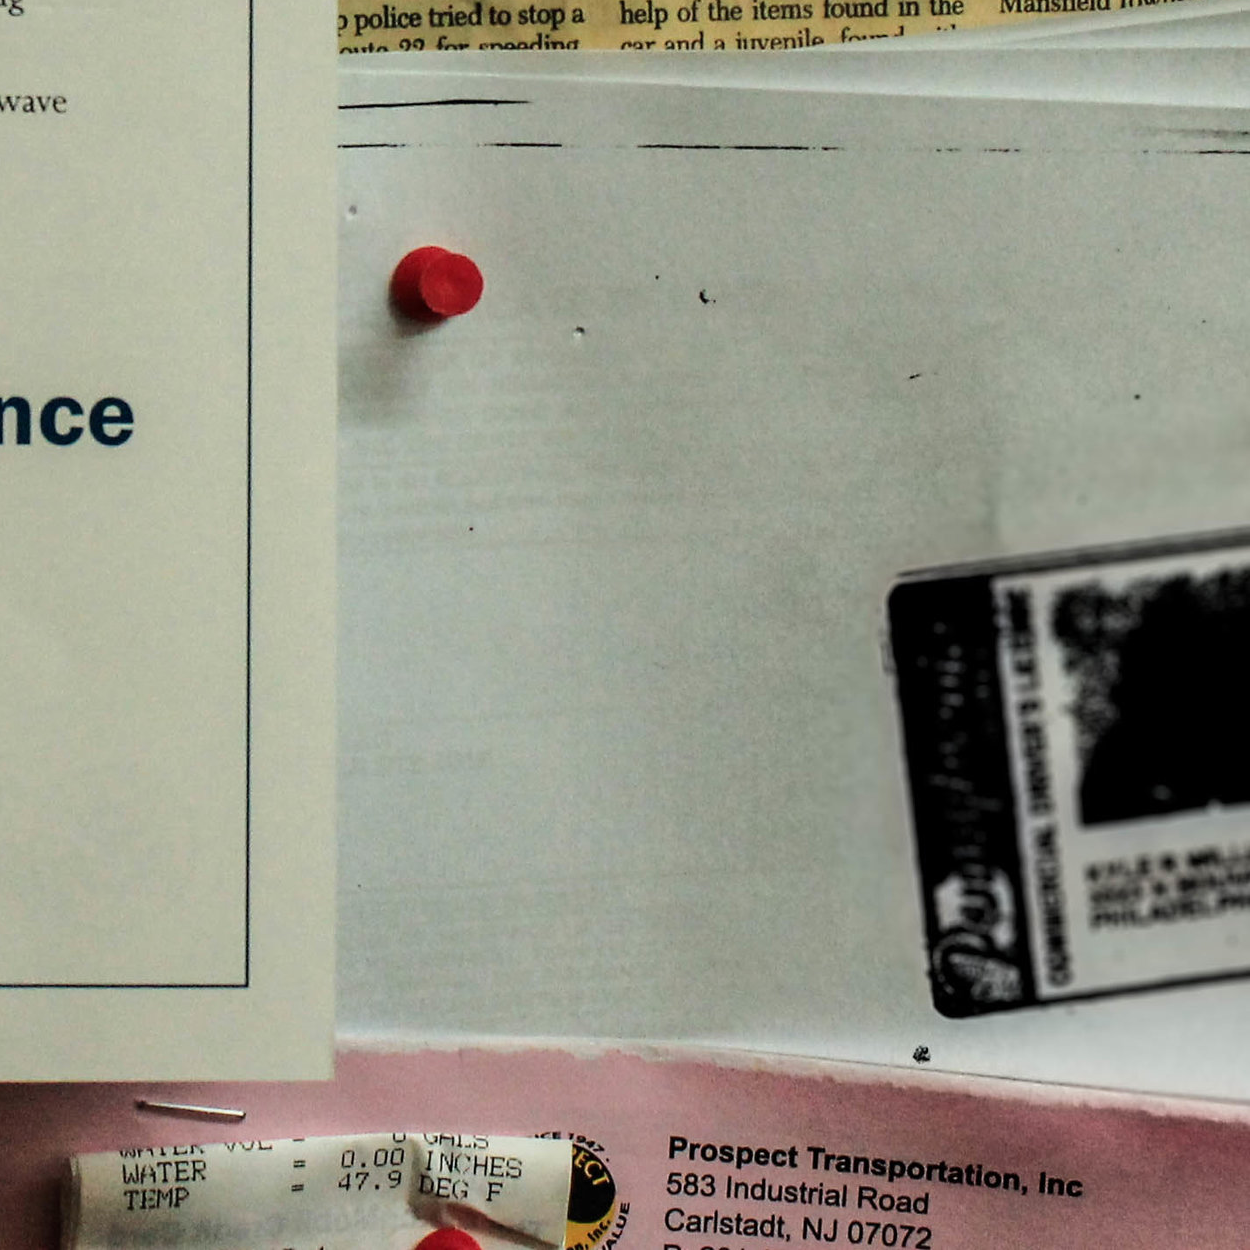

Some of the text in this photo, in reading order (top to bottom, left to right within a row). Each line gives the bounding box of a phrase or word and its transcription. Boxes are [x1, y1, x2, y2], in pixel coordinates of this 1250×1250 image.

[123, 1161, 207, 1186] WATER
[341, 1148, 405, 1170] 0.00
[423, 1151, 523, 1179] INCHES
[668, 1135, 1083, 1199] Prospect Transportation, Inc
[124, 1187, 191, 1211] TEMP
[338, 1171, 402, 1192] 47.9
[419, 1177, 470, 1200] DEG
[486, 1182, 504, 1203] F
[666, 1171, 930, 1216] 583 Industrial Road
[664, 1206, 932, 1250] Carlstadt, NJ 07072
